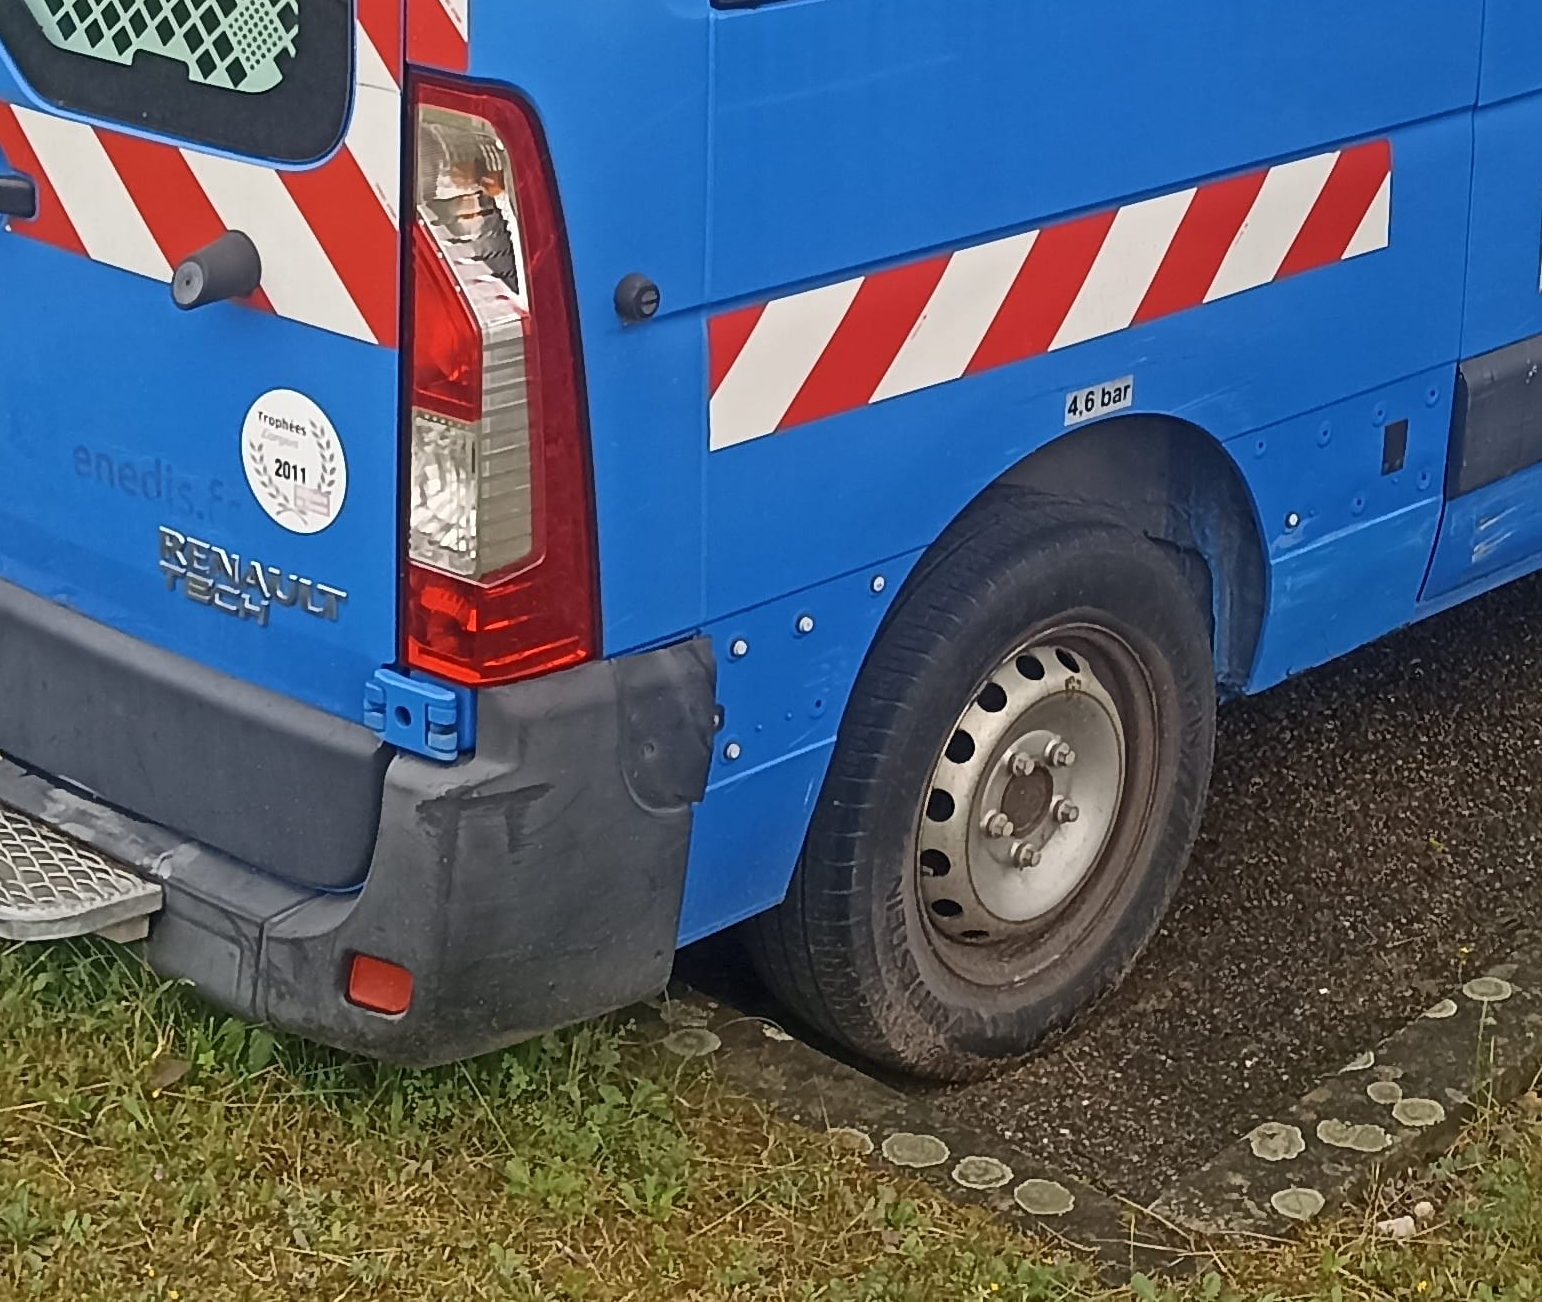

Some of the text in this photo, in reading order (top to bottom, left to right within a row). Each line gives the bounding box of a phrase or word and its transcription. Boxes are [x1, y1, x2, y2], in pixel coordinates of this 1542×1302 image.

[1067, 384, 1131, 417] 4,6 bar
[257, 411, 307, 437] Trophées
[274, 458, 307, 485] 2011
[159, 526, 347, 622] RENAULT
[159, 560, 269, 628] TECH
